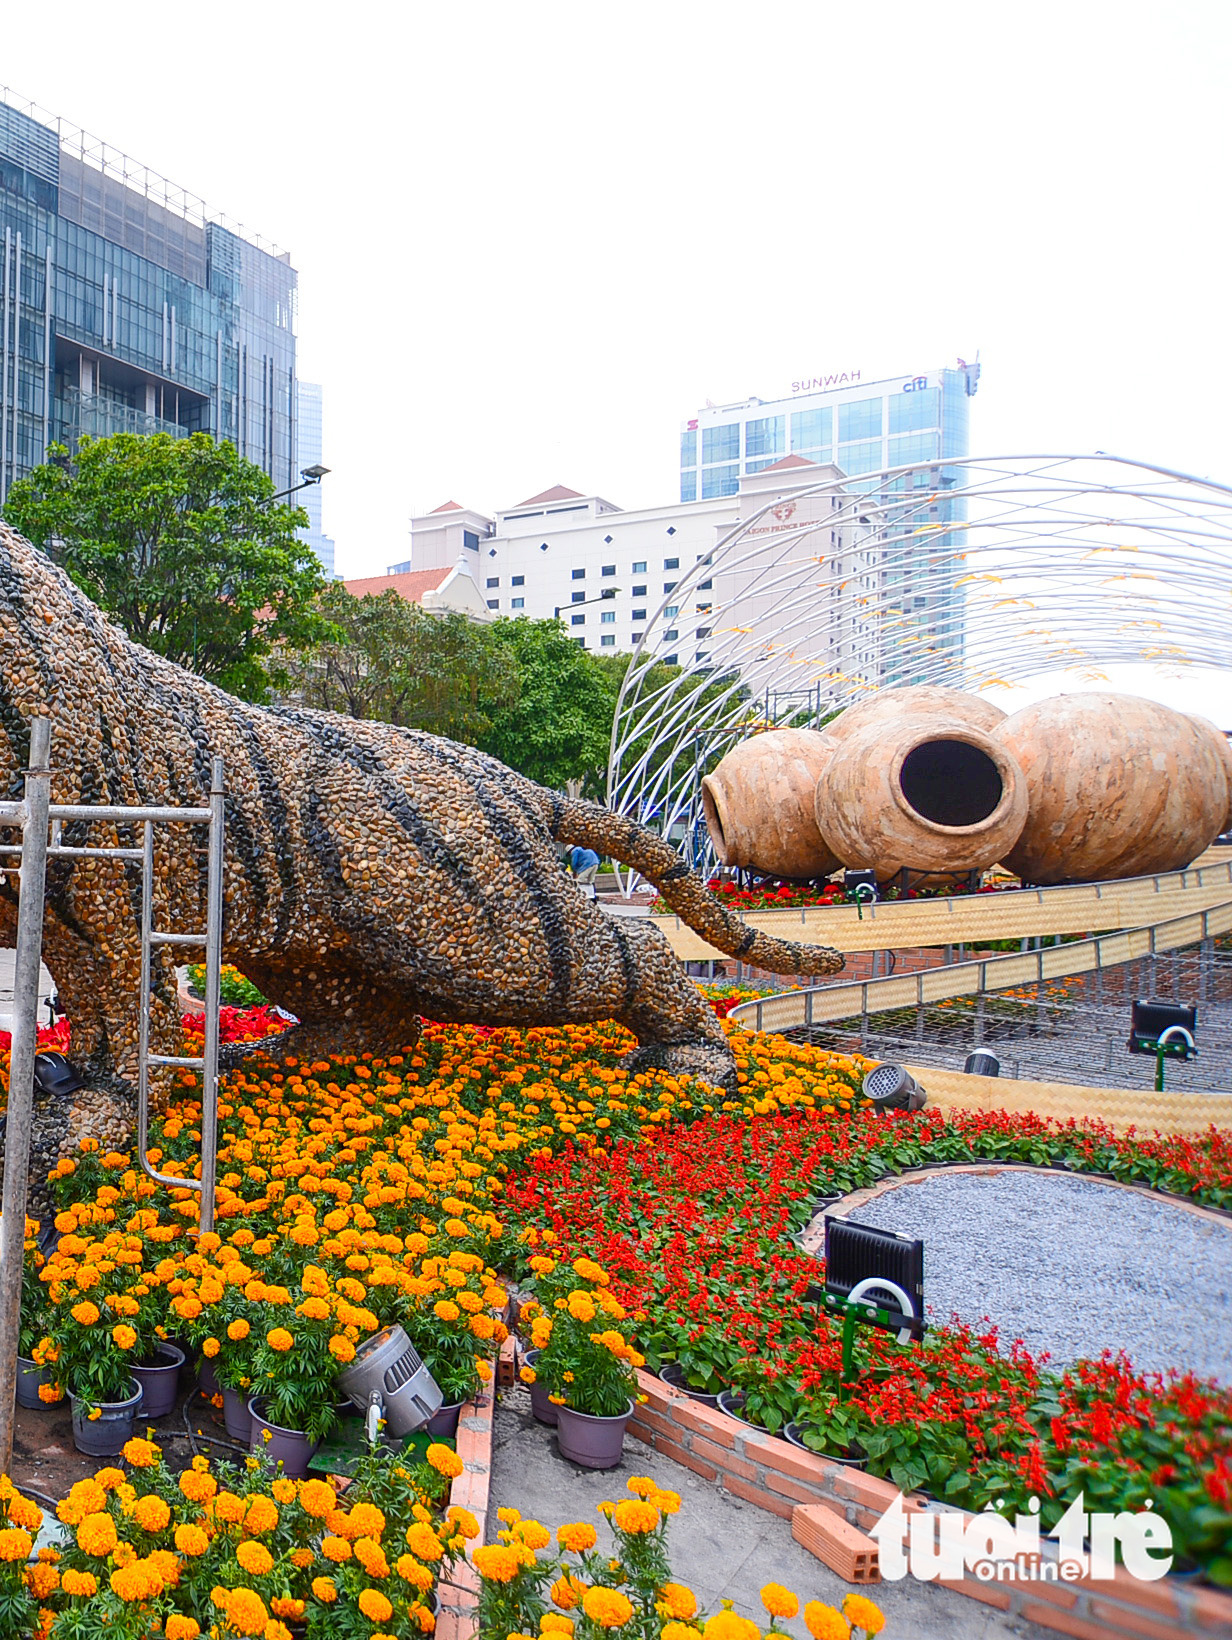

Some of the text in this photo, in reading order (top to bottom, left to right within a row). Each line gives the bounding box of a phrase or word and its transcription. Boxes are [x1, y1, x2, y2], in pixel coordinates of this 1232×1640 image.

[791, 369, 861, 392] SUNWAH
[902, 376, 928, 393] citi
[747, 526, 770, 535] AIGON
